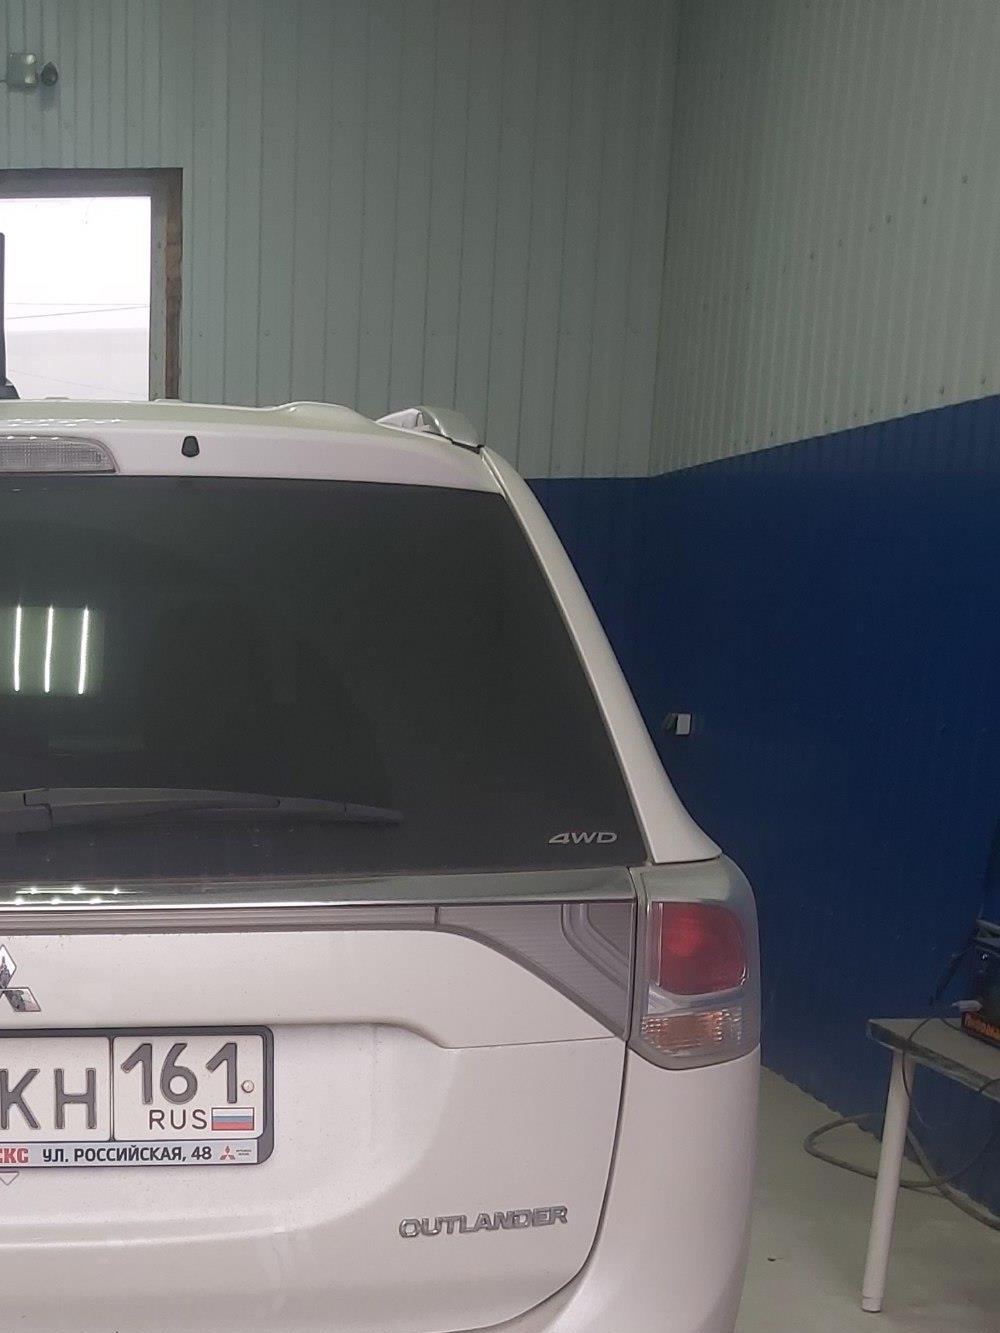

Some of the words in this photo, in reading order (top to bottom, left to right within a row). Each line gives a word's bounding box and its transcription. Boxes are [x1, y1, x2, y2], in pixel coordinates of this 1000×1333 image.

[548, 831, 618, 844] 4WD
[121, 1042, 238, 1105] 161
[149, 1108, 208, 1130] RUS
[42, 1148, 69, 1163] УЛ.
[74, 1144, 187, 1163] РОССИЙСКАЯ,
[191, 1146, 212, 1160] 48
[399, 1205, 568, 1238] OUTLANDER
